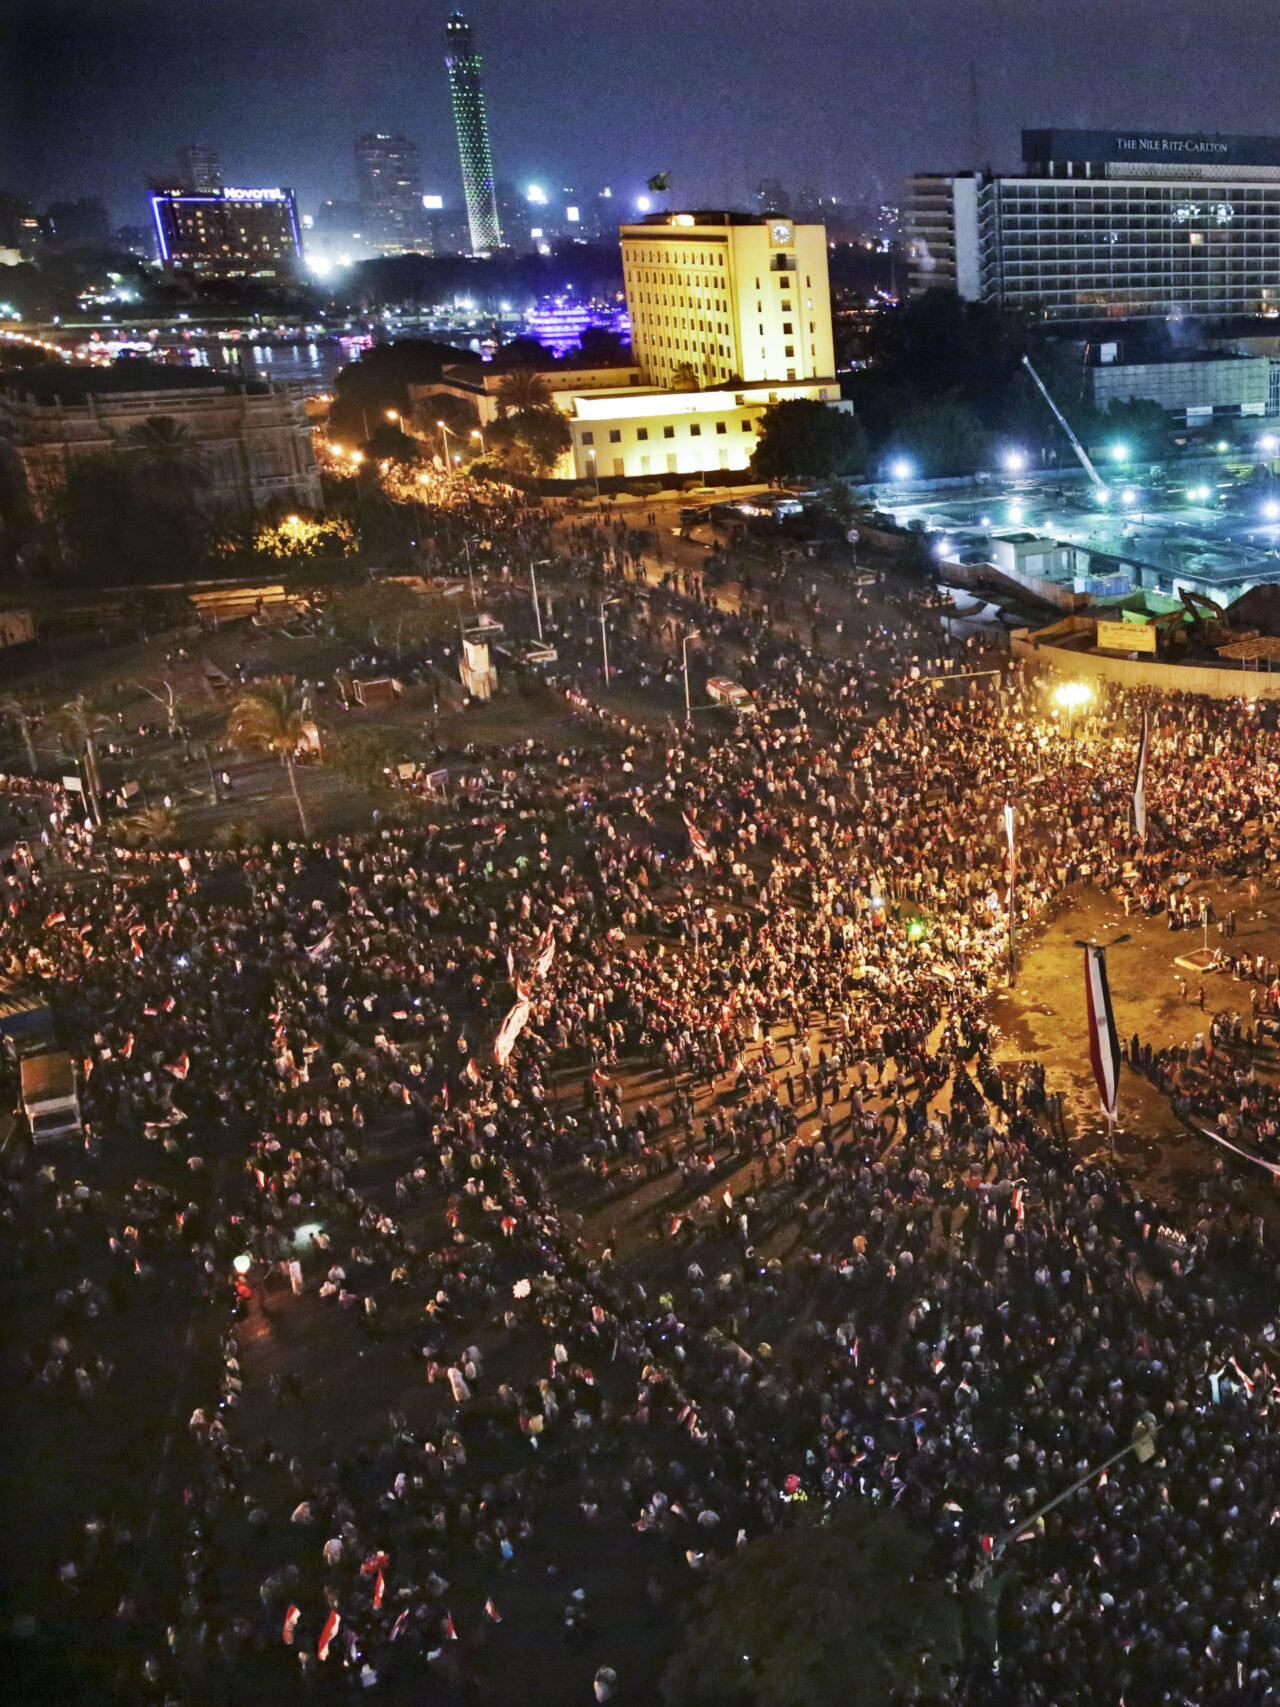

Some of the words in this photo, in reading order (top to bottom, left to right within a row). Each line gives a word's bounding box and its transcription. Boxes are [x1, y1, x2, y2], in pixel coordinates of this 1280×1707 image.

[1117, 138, 1137, 150] THE
[1139, 138, 1160, 150] NILE
[224, 187, 286, 199] NOVOTEL
